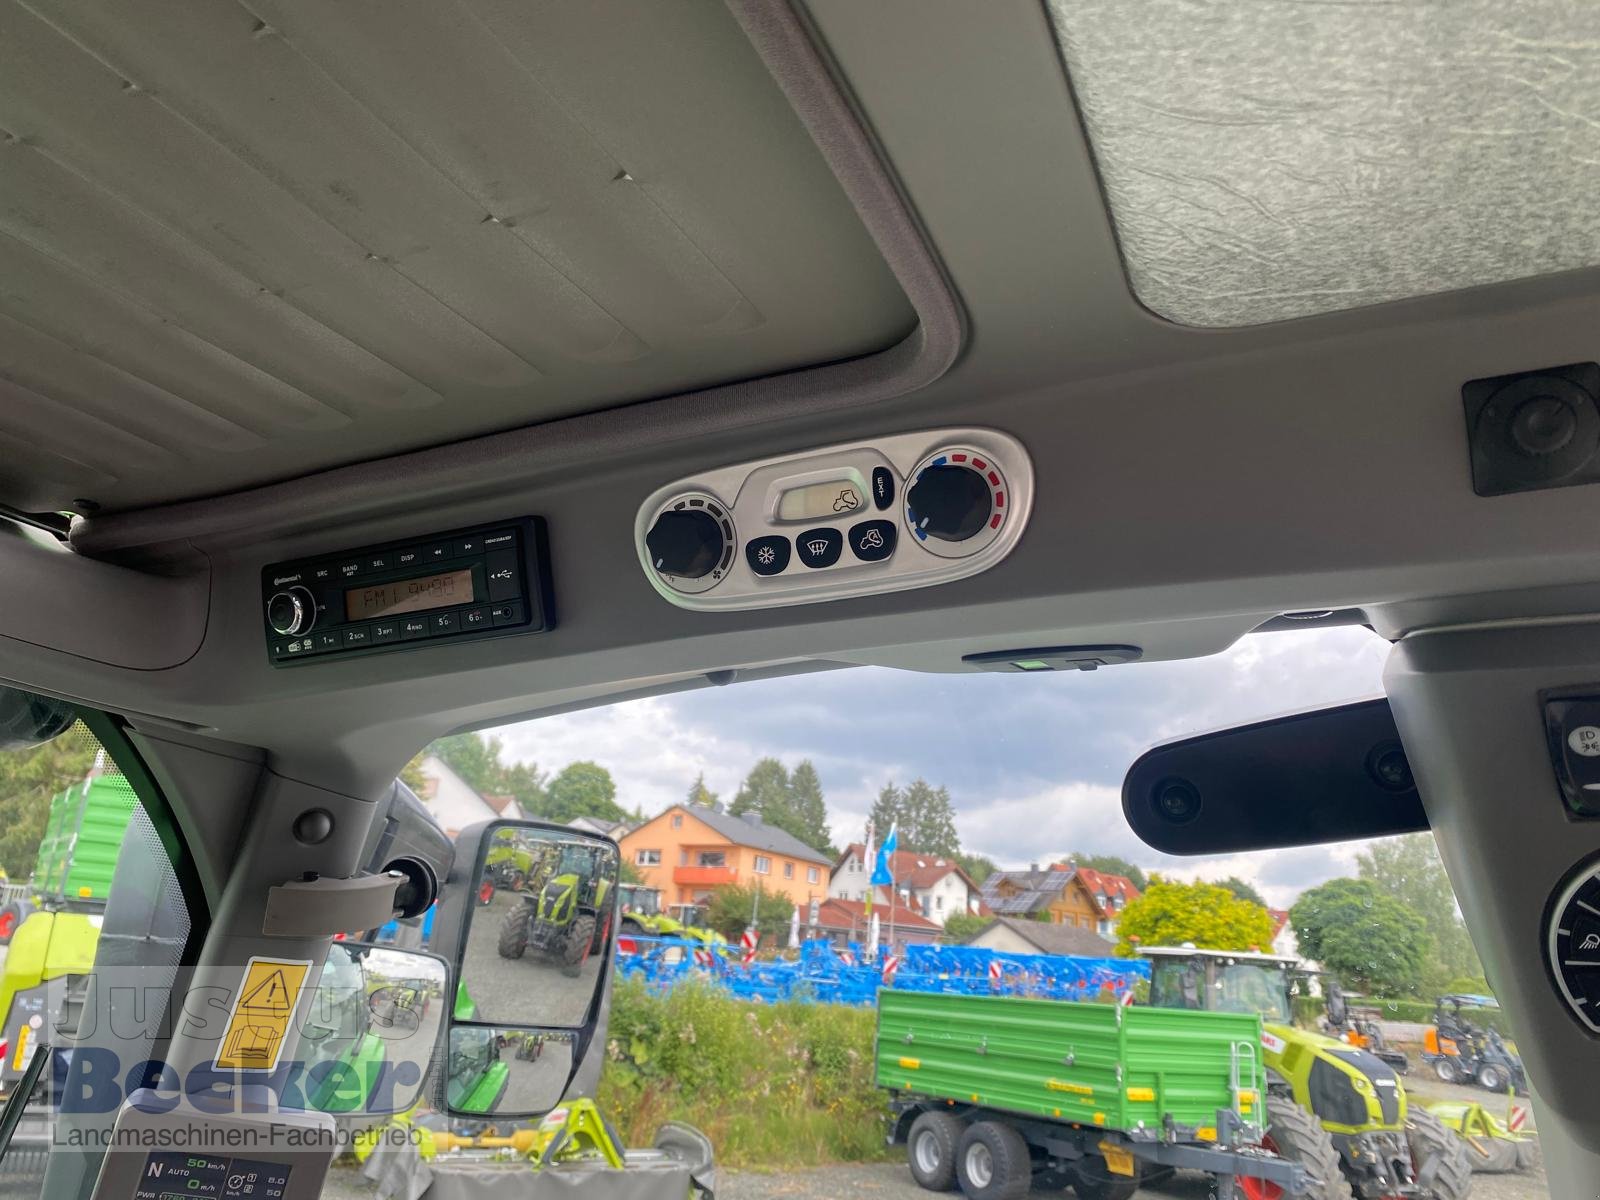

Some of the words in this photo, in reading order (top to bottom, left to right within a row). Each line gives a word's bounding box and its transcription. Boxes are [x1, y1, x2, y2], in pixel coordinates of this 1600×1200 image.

[401, 553, 415, 562] DISP
[342, 564, 358, 573] BAND
[147, 1161, 164, 1178] N
[168, 1168, 190, 1177] AUTO
[187, 1158, 207, 1168] 50
[207, 1163, 226, 1171] km/h
[187, 1179, 200, 1190] 0
[136, 1191, 155, 1199] PWR
